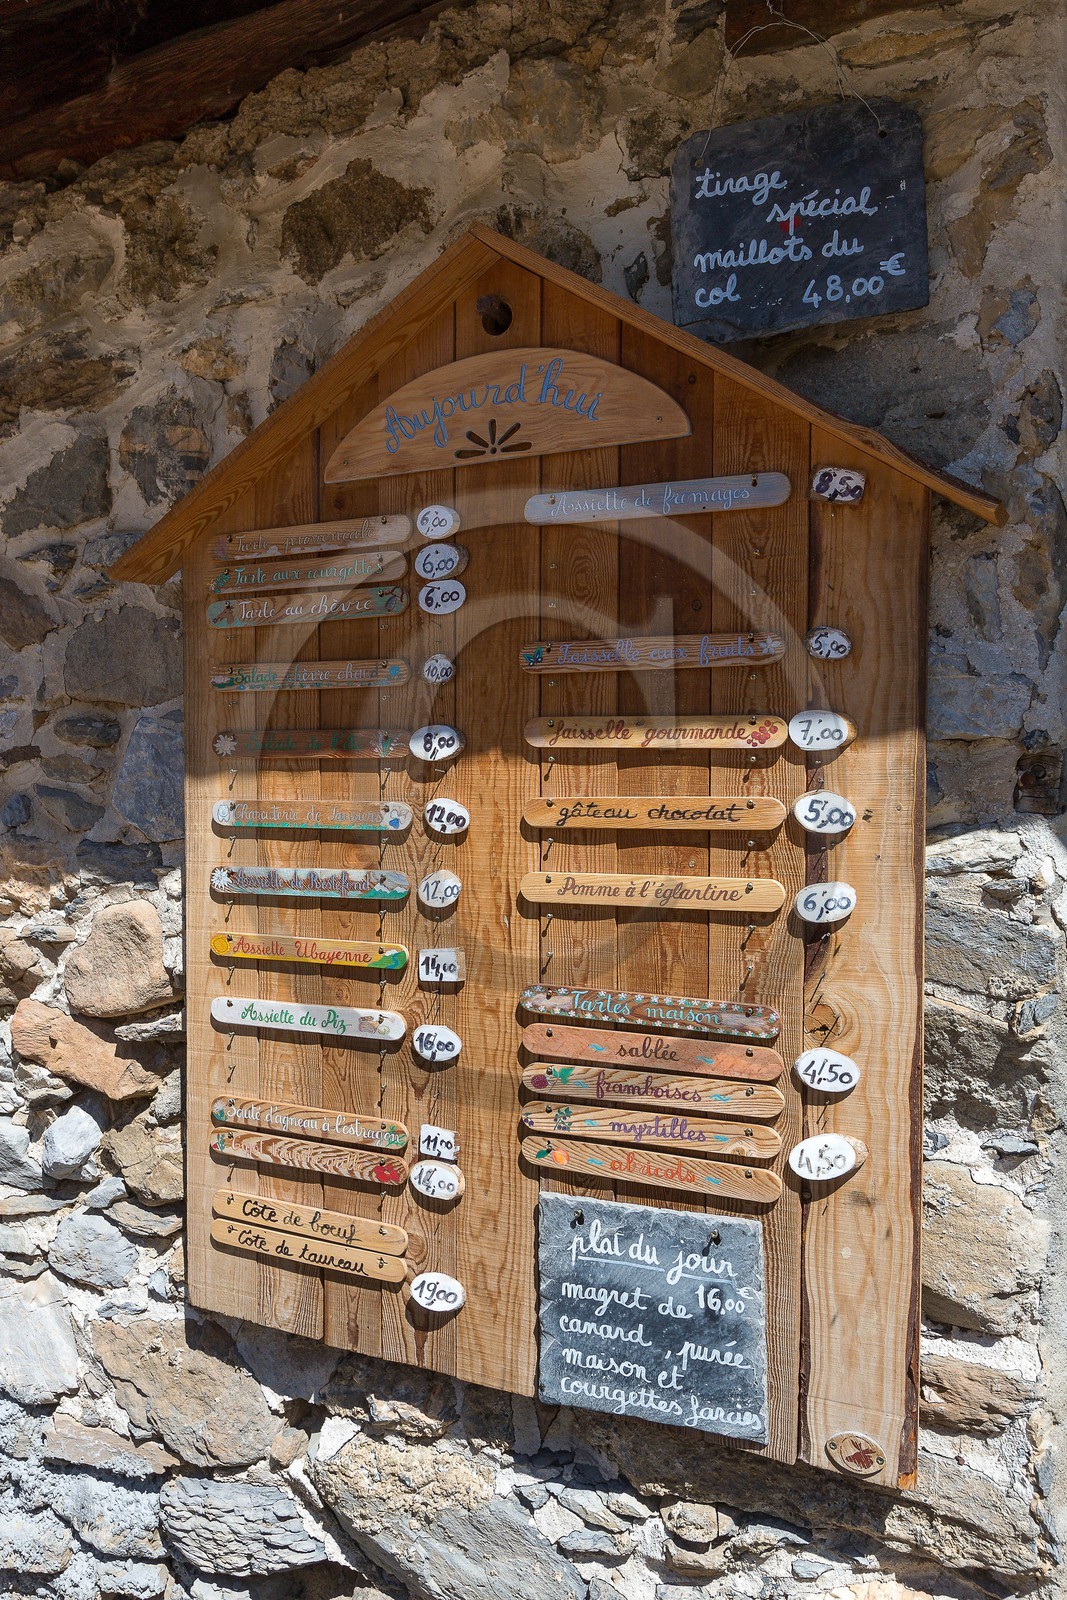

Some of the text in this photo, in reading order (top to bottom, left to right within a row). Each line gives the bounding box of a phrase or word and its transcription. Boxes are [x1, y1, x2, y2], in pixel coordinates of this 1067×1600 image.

[695, 168, 787, 205] tirage
[766, 187, 878, 235] spécial
[694, 230, 864, 272] maillots du
[695, 274, 741, 307] col
[385, 358, 603, 453] Aujourd'hui
[551, 484, 751, 517] Assiette de fromages
[236, 534, 269, 552] Tarte
[235, 559, 383, 586] Tarte aux courgettes
[422, 553, 454, 578] 6,00
[238, 595, 372, 620] Tarte au chèvre
[424, 587, 460, 609] 6,00
[650, 647, 688, 660] aux
[699, 636, 756, 667] fruits
[235, 662, 378, 684] Salade chèvre chaud
[425, 664, 452, 682] 10,00
[640, 718, 750, 748] gourmande
[306, 805, 321, 822] de
[556, 801, 747, 827] gâteau chocolat
[803, 799, 854, 829] 5,00
[557, 877, 743, 907] Pomme à l'églantine
[803, 892, 852, 920] 6,00
[232, 936, 373, 964] Assiette Ubayenne
[241, 1002, 295, 1024] Assiette
[300, 1009, 317, 1027] du
[570, 990, 723, 1025] Tartes maison
[615, 1037, 680, 1062] sablée
[596, 1071, 702, 1103] framboises
[227, 1103, 403, 1147] Sauté d'agneau à l'estragon
[609, 1116, 708, 1143] myrtilles
[610, 1155, 696, 1184] abricots
[242, 1199, 278, 1223] Côte
[283, 1210, 301, 1226] de
[275, 1239, 294, 1257] de
[298, 1244, 369, 1277] taureau
[567, 1219, 738, 1285] plat du jour
[413, 1279, 458, 1306] 19,00
[561, 1282, 651, 1316] magret
[658, 1297, 693, 1320] de
[559, 1315, 652, 1347] canard
[561, 1348, 684, 1390] maison et
[560, 1376, 762, 1429] courgettes farcies
